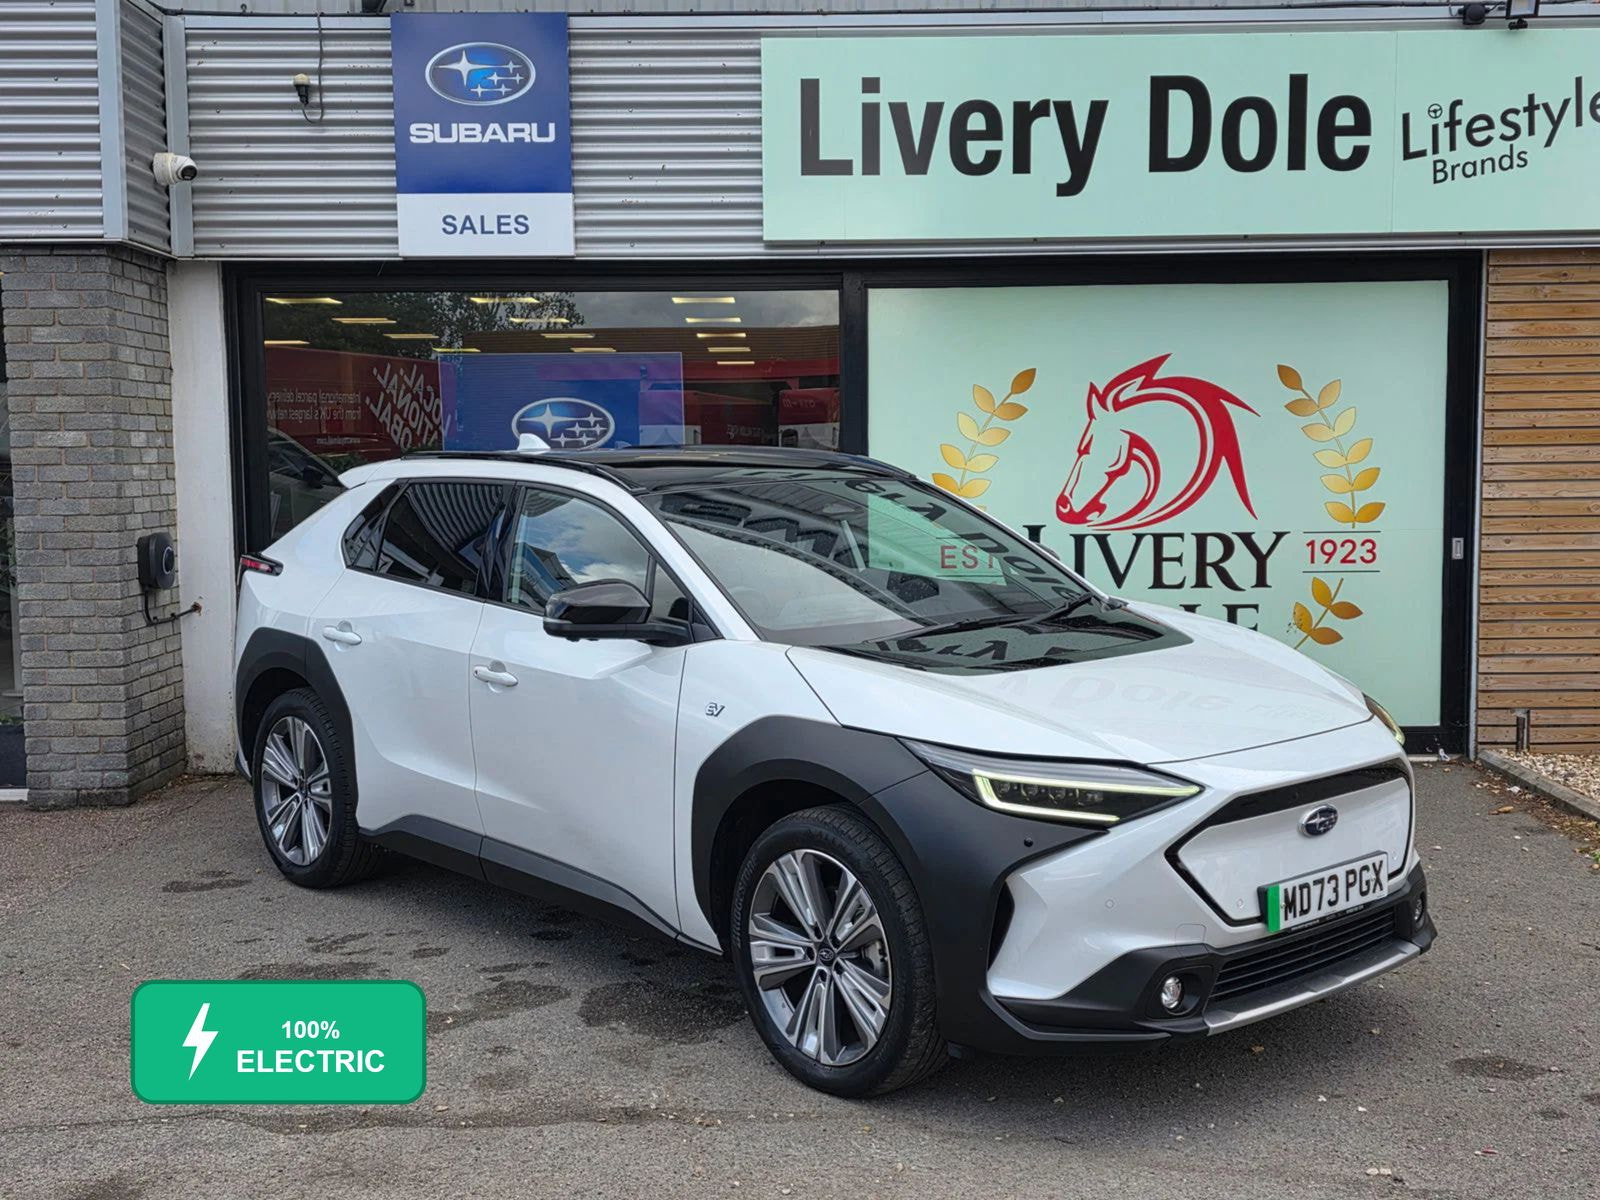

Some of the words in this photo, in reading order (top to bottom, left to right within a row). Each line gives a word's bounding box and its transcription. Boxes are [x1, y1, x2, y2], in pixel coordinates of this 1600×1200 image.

[409, 122, 556, 144] SUBARU
[800, 76, 1109, 197] Livery
[1148, 73, 1372, 172] Dole
[1432, 143, 1528, 184] Brands
[441, 214, 530, 235] SALES
[1306, 538, 1377, 564] 1923
[1284, 873, 1339, 921] MD73
[1345, 860, 1384, 902] PGX
